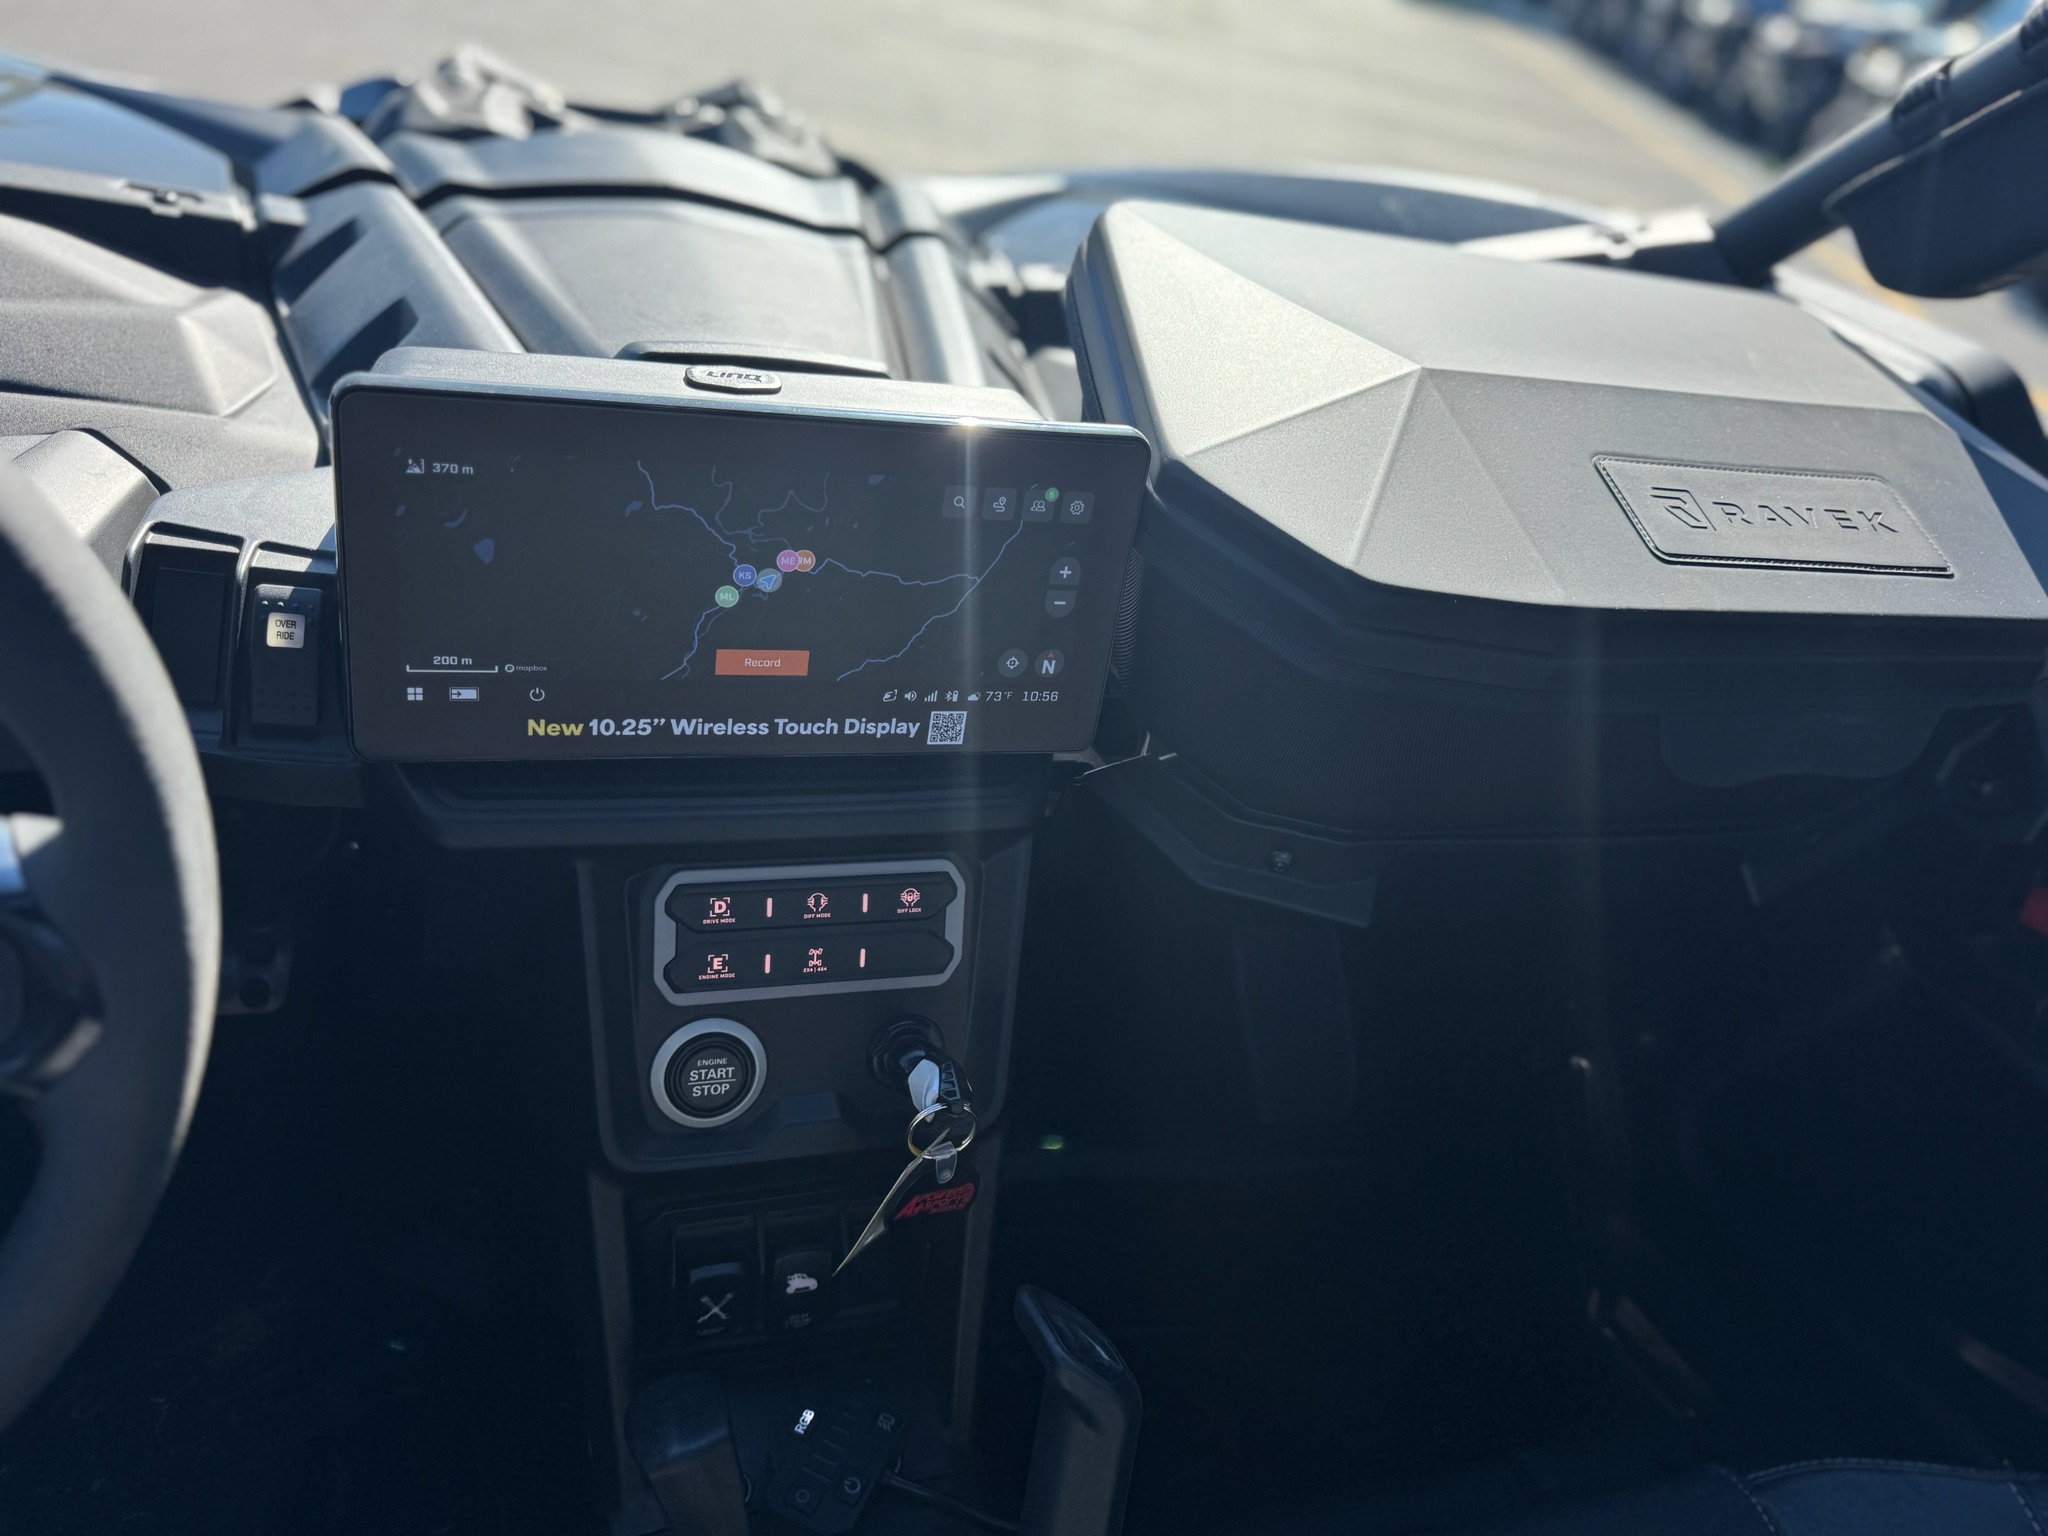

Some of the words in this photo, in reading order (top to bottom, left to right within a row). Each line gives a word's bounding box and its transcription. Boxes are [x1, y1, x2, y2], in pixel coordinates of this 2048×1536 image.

[432, 463, 458, 474] 370
[462, 466, 474, 475] m
[1711, 501, 1899, 533] RAVEK
[781, 557, 796, 566] ME
[738, 572, 752, 580] KS
[720, 592, 734, 601] ML
[275, 619, 297, 630] OVER
[276, 630, 295, 641] RIDE
[433, 656, 458, 665] 200
[461, 657, 473, 665] m
[744, 658, 781, 667] Record
[516, 665, 548, 673] mapbox
[1041, 659, 1056, 674] N
[1022, 691, 1060, 702] 10:56
[527, 719, 584, 736] New
[670, 718, 769, 736] Wireless
[774, 718, 839, 736] Touch
[844, 717, 921, 738] Display
[714, 900, 727, 914] D
[713, 957, 723, 970] E
[697, 1057, 728, 1067] ENGINE
[689, 1066, 735, 1082] START
[692, 1083, 730, 1098] STOP
[794, 1408, 815, 1435] RGB
